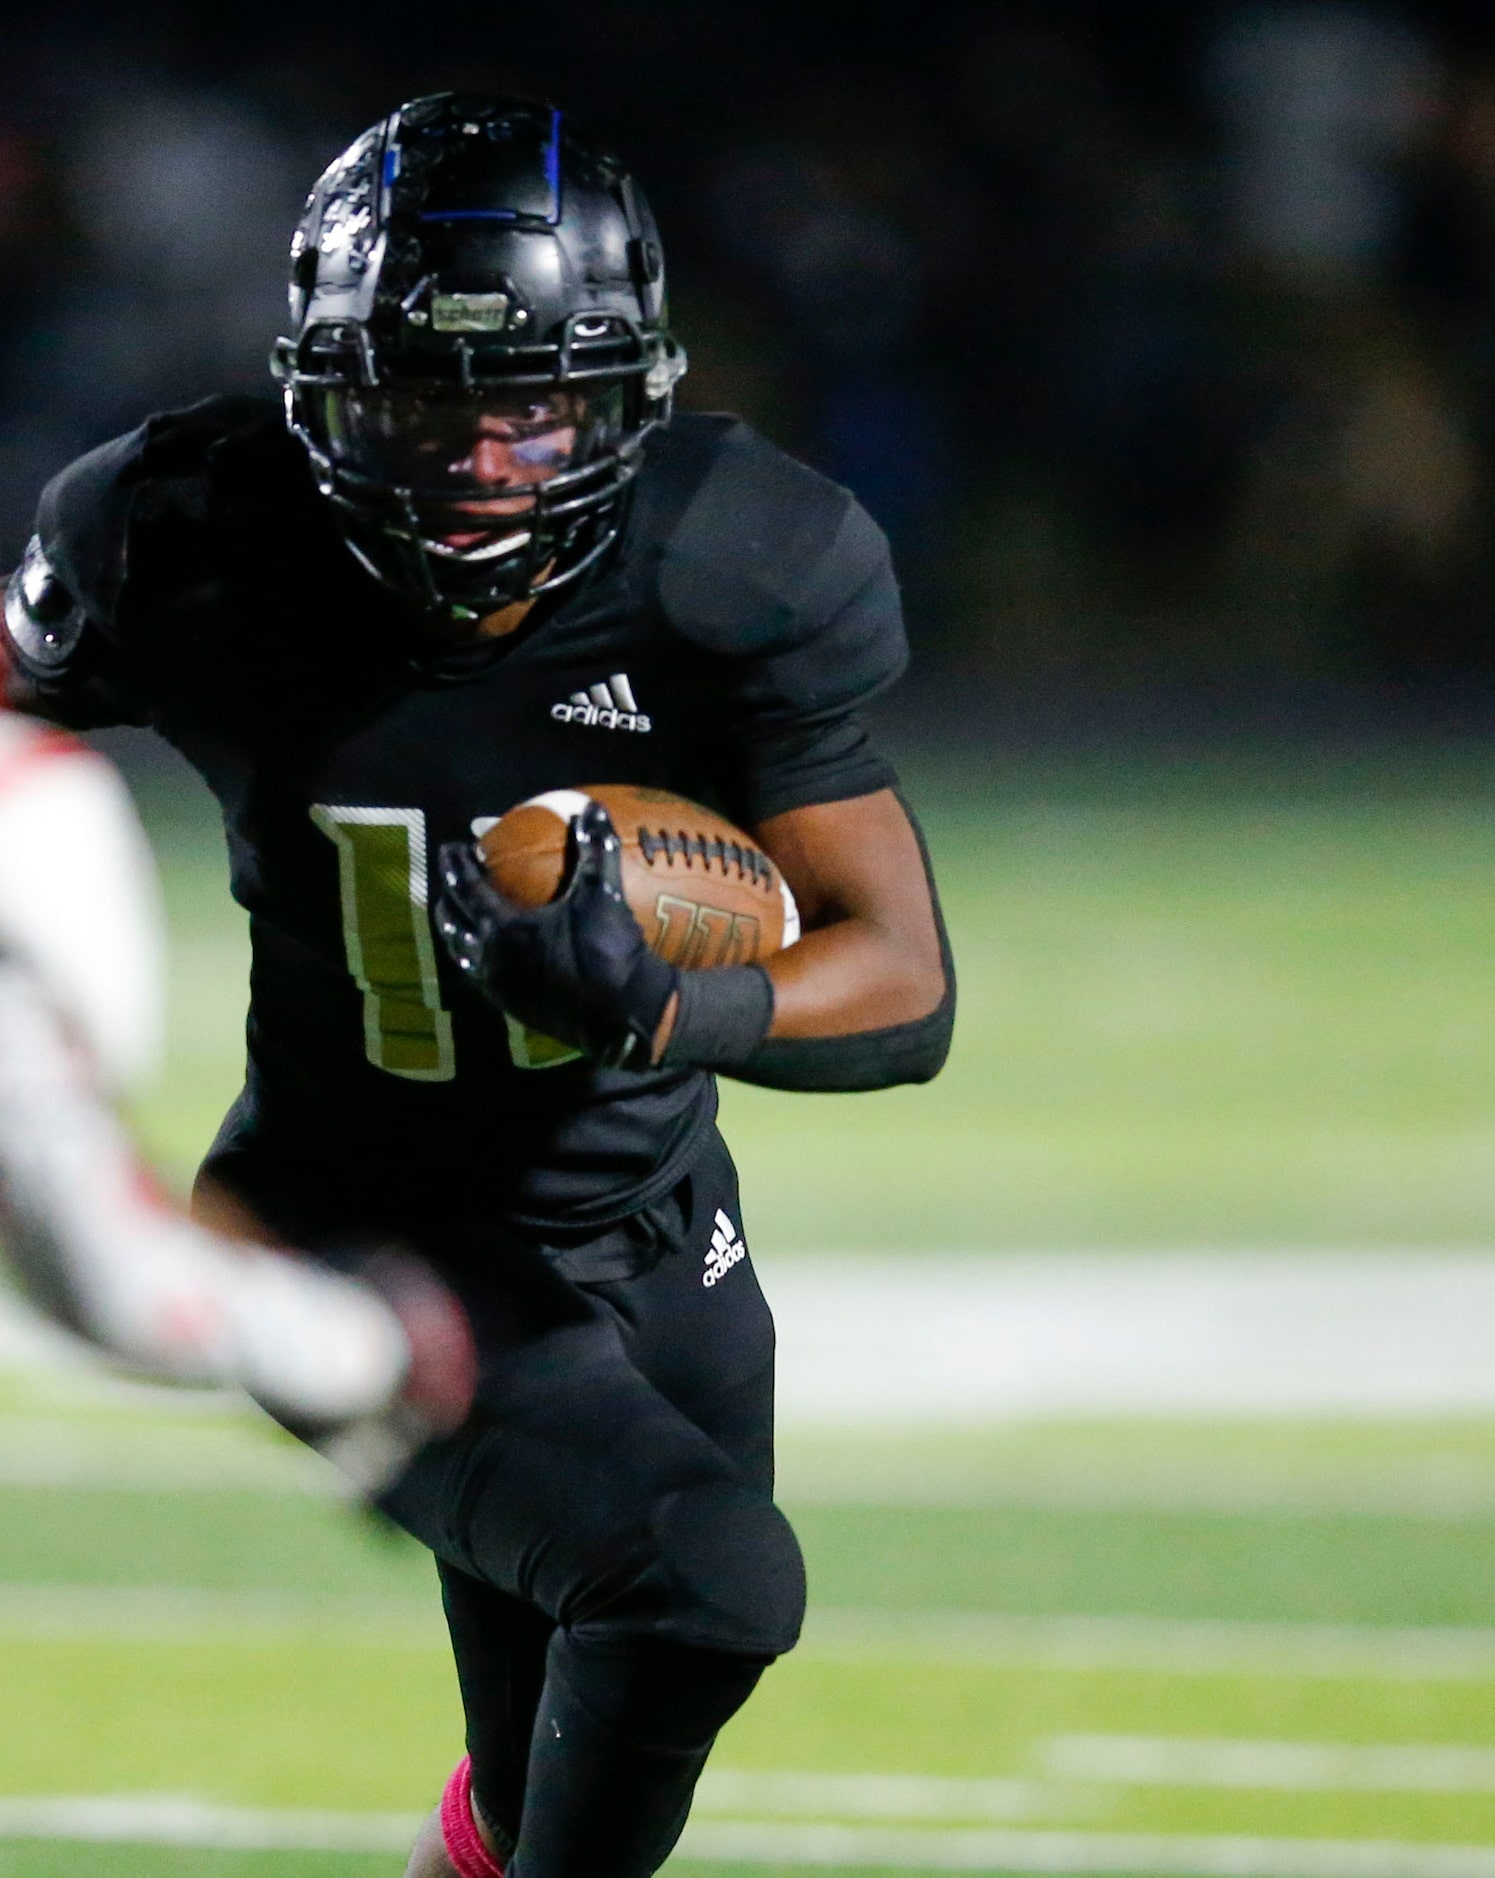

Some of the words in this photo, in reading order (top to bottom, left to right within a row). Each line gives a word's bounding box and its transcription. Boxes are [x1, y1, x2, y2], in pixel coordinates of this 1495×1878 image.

[550, 703, 652, 733] adidas
[308, 803, 588, 1082] 1
[702, 1239, 746, 1288] adidas
